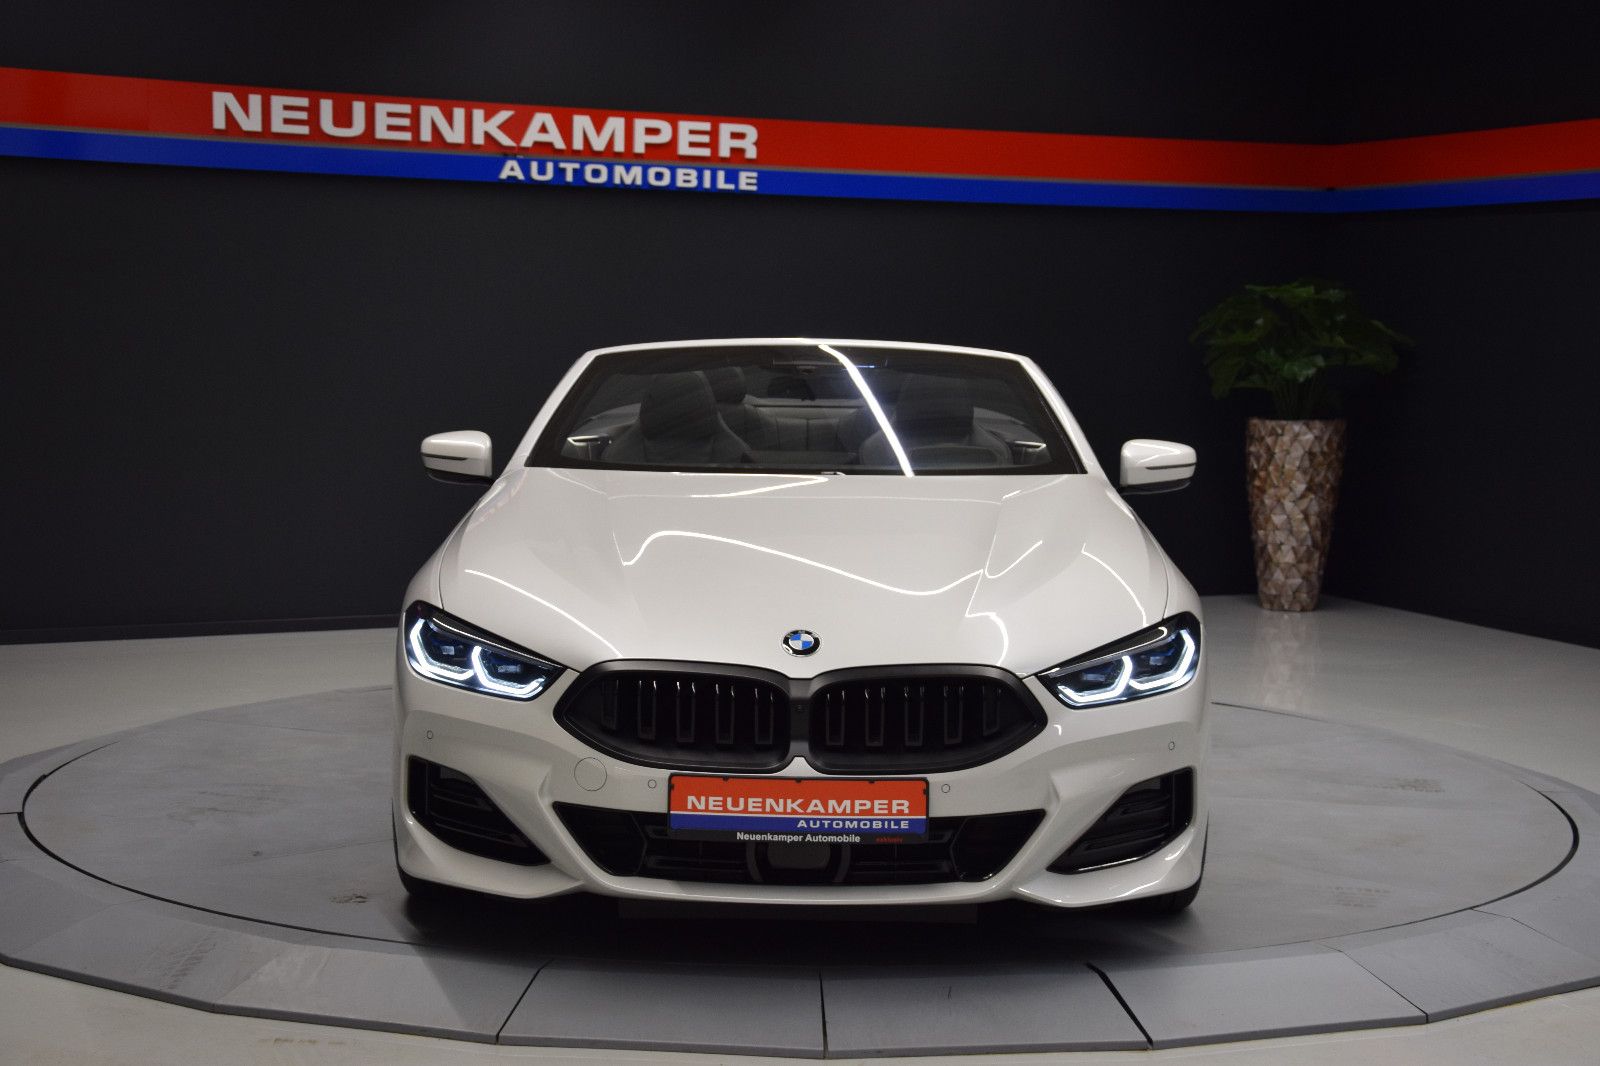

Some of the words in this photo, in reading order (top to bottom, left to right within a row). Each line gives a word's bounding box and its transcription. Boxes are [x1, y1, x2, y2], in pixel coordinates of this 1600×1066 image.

[212, 91, 759, 160] NEUENKAMPER
[499, 159, 759, 192] AUTOMOBILE
[687, 795, 910, 814] NEUENKAMPER
[797, 819, 909, 829] AUTOMOBILE
[736, 831, 803, 843] Neuenkamper
[805, 833, 861, 842] Automobile
